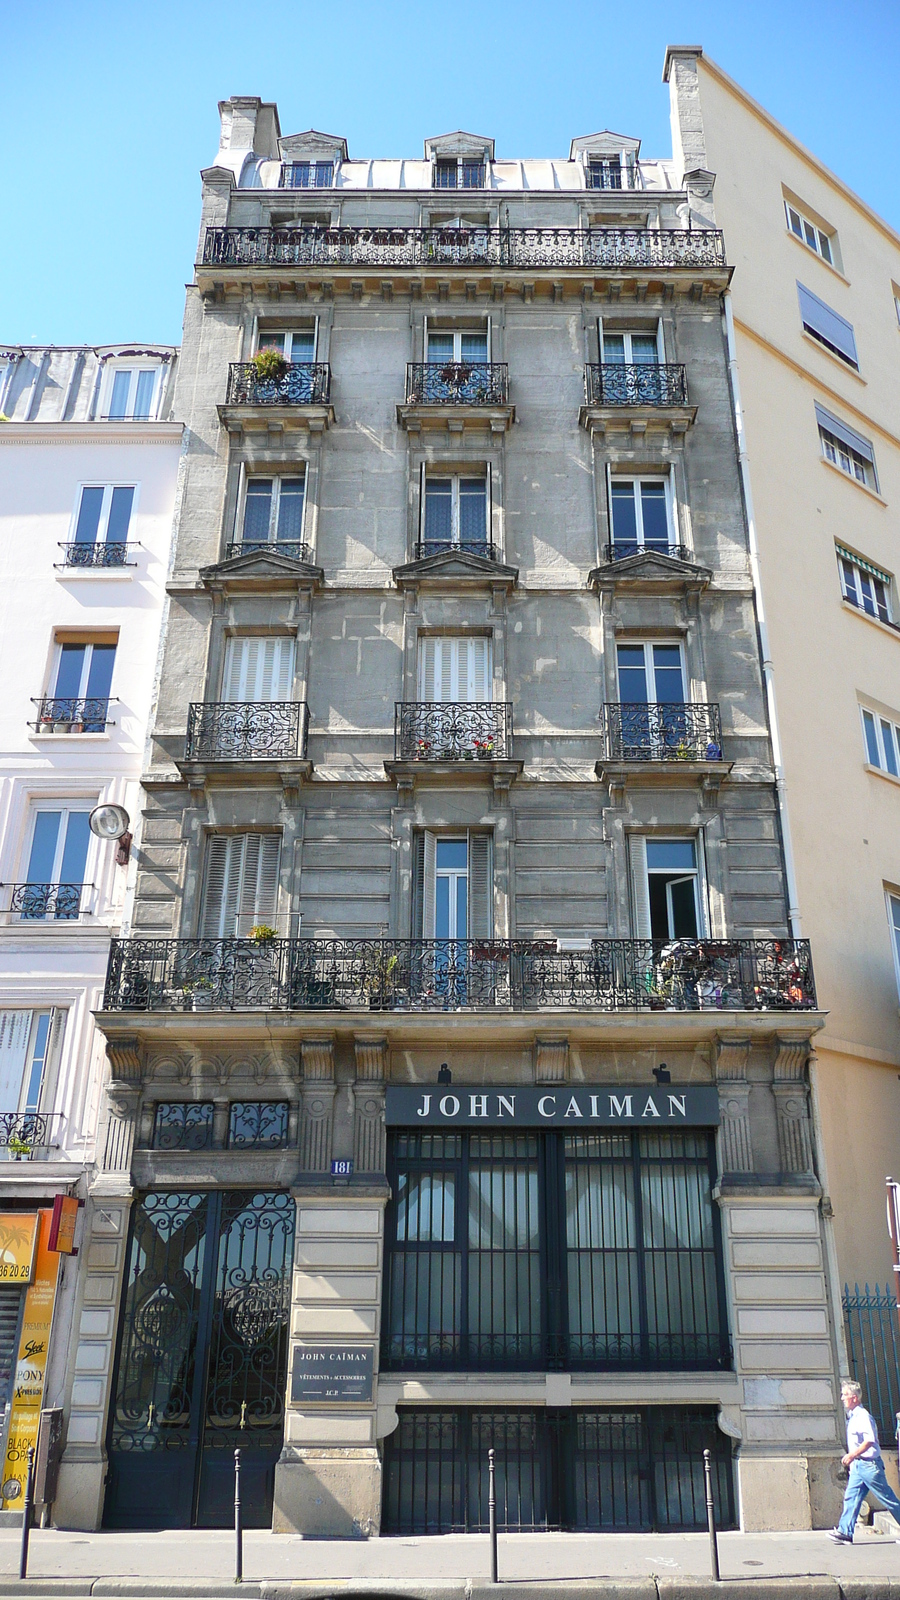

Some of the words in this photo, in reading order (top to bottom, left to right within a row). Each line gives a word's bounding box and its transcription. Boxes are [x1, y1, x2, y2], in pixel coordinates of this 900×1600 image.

[417, 1094, 516, 1117] JOHN
[537, 1094, 687, 1118] CAIMAN
[334, 1161, 350, 1174] 181
[9, 1265, 19, 1277] 20
[20, 1265, 30, 1277] 29
[300, 1353, 326, 1361] JOHN
[17, 1370, 44, 1381] PONY
[8, 1438, 32, 1449] BLACK
